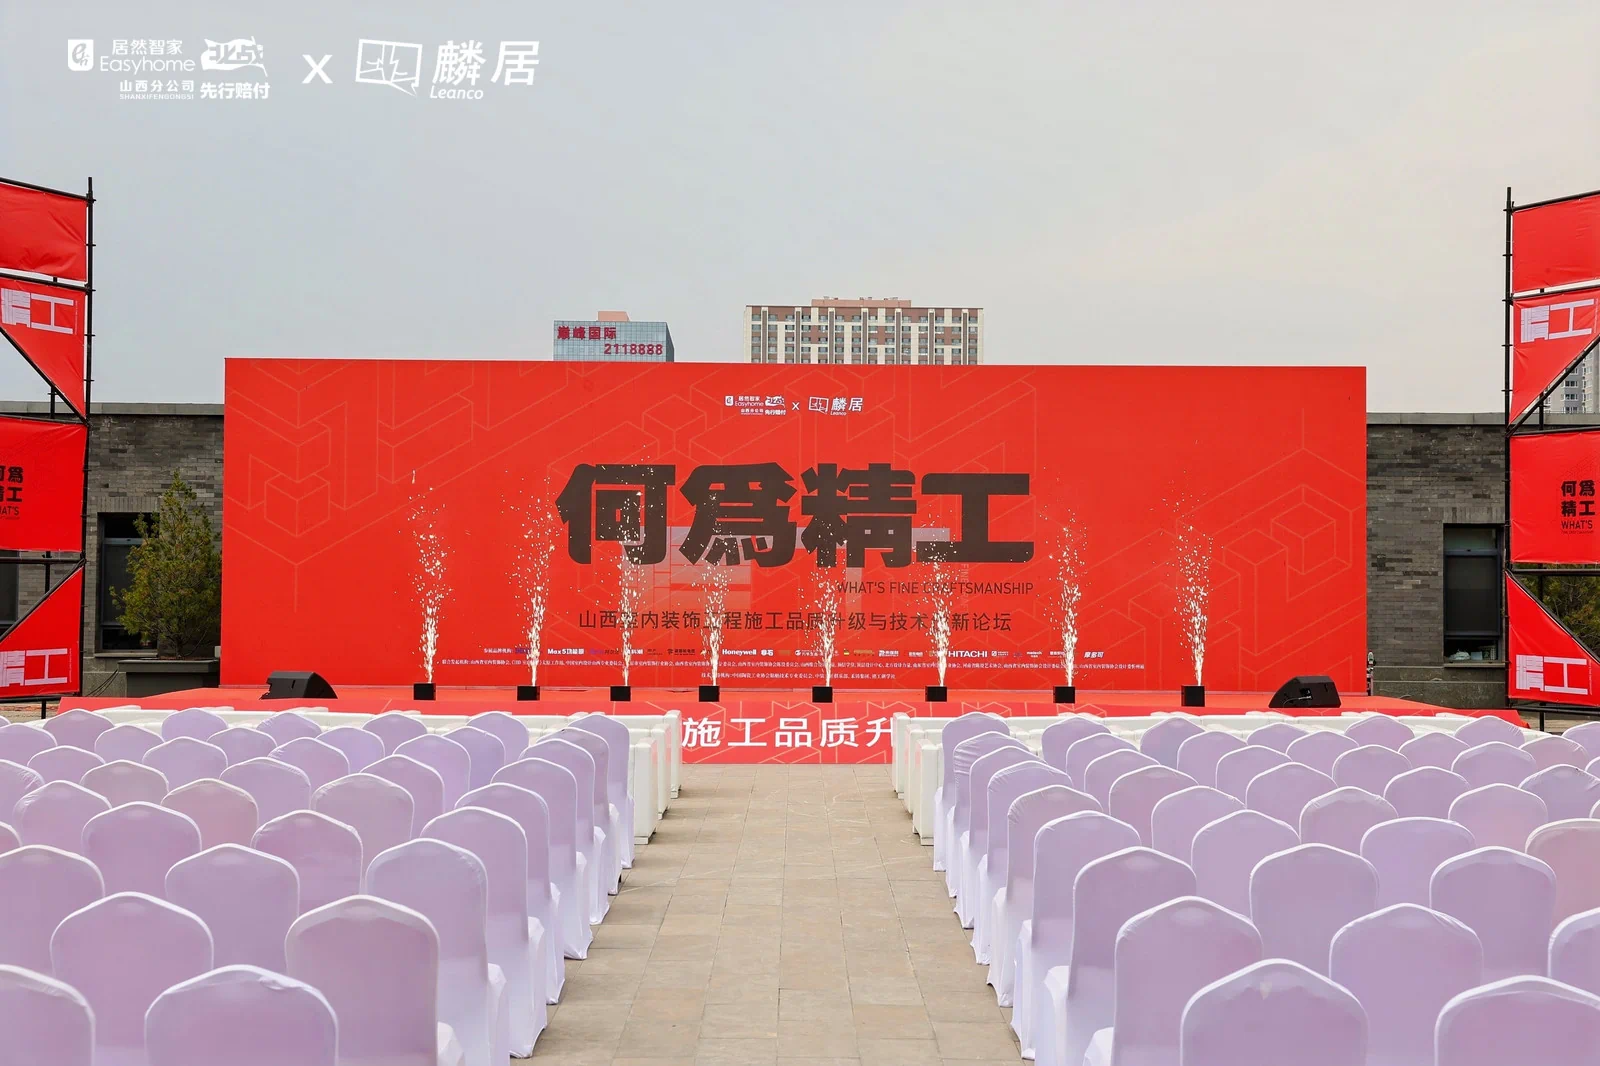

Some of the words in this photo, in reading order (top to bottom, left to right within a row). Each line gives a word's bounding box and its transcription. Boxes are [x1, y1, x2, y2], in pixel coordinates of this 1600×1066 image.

[603, 343, 663, 355] 2118888
[1561, 520, 1593, 530] WHAT'S
[838, 582, 886, 594] WHAT'S
[889, 582, 919, 594] FINE
[923, 582, 1034, 595] CRAFTSMANSHIP
[579, 610, 1012, 631] 山西室内装饰工程施工品质升级与技术新论坛
[948, 650, 988, 658] HITACHI
[682, 717, 893, 747] 施工品质升
